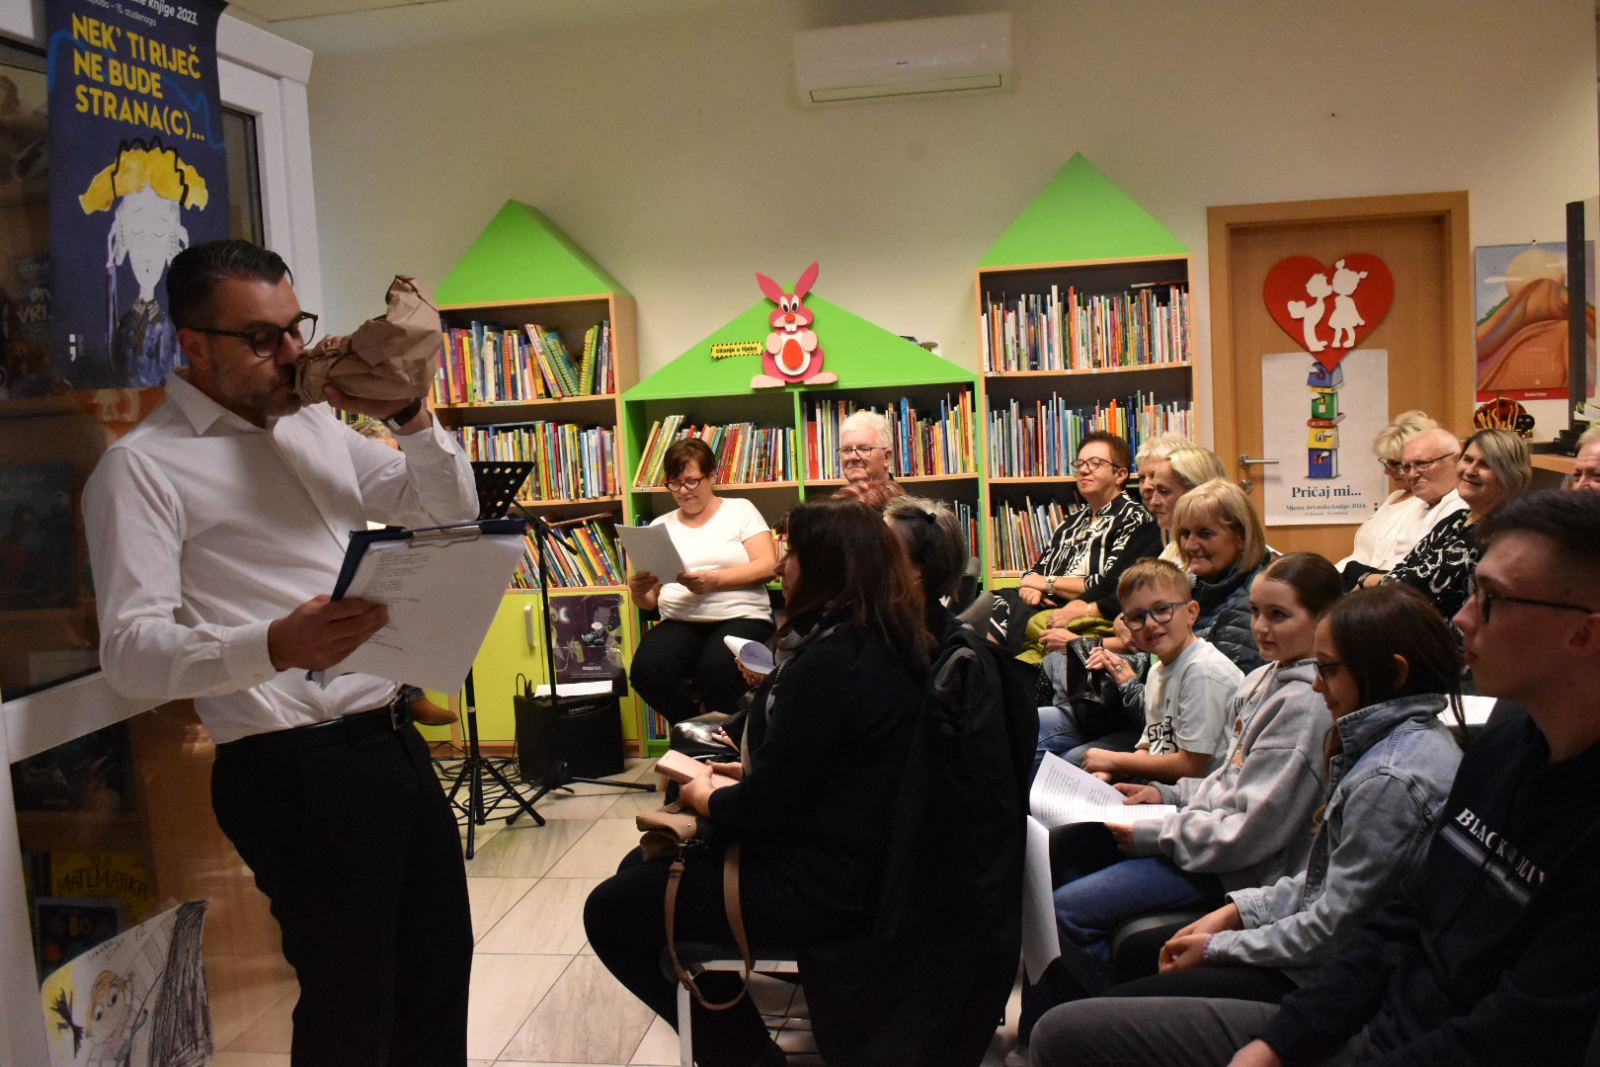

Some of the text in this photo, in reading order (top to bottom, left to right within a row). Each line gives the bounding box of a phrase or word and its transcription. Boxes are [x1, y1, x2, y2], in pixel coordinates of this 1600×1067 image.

[147, 0, 199, 26] knjige 2023.
[74, 48, 163, 99] NE BUDE
[127, 31, 145, 61] TI
[149, 40, 201, 79] RIJEČ
[75, 84, 205, 140] STRANA(C)...
[1292, 485, 1361, 499] Pričaj mi...
